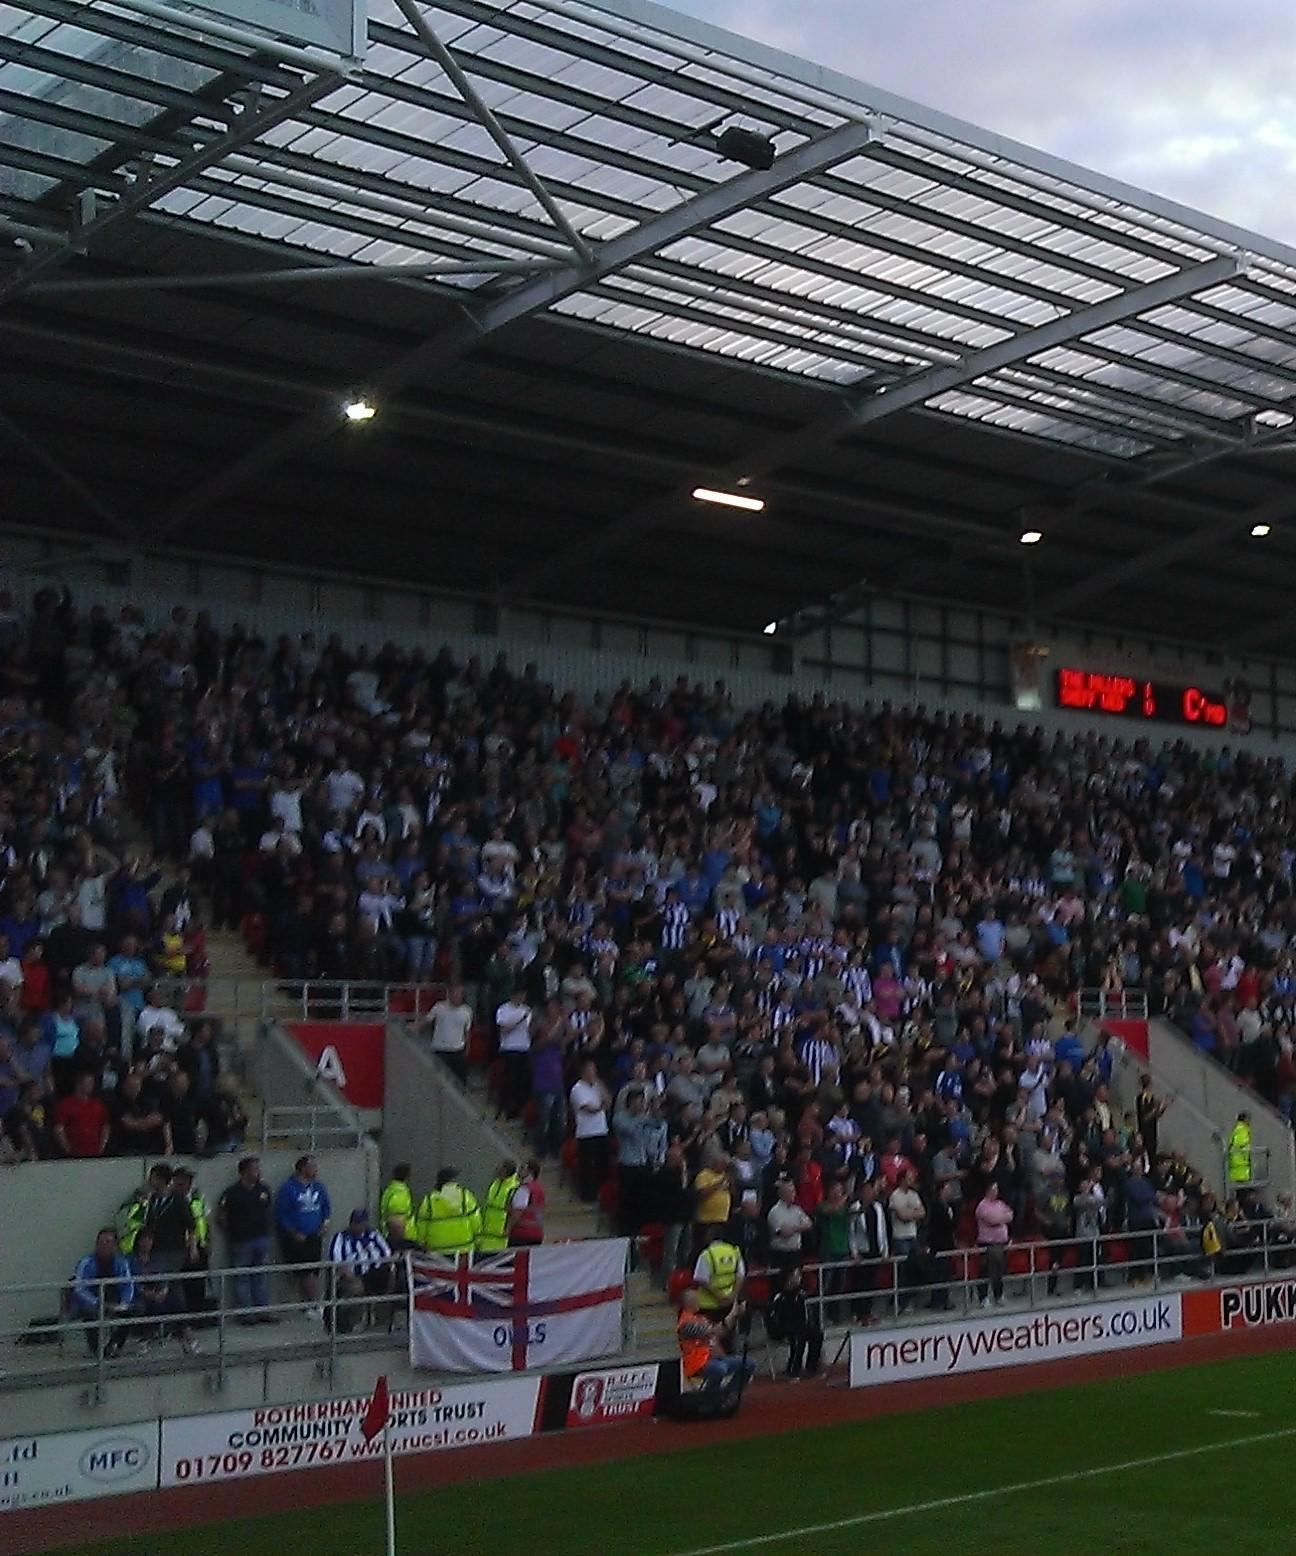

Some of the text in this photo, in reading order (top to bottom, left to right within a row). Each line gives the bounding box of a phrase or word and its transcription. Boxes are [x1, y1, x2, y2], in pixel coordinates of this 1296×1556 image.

[315, 1044, 347, 1089] A
[867, 1301, 1171, 1370] merryweathers.co.uk
[228, 1401, 487, 1449] COMMUNITY ORTS TRUST
[254, 1388, 442, 1427] ROTHERHAM NITED
[89, 1449, 139, 1471] MFC
[176, 1452, 252, 1479] 01709
[260, 1439, 347, 1468] 827767
